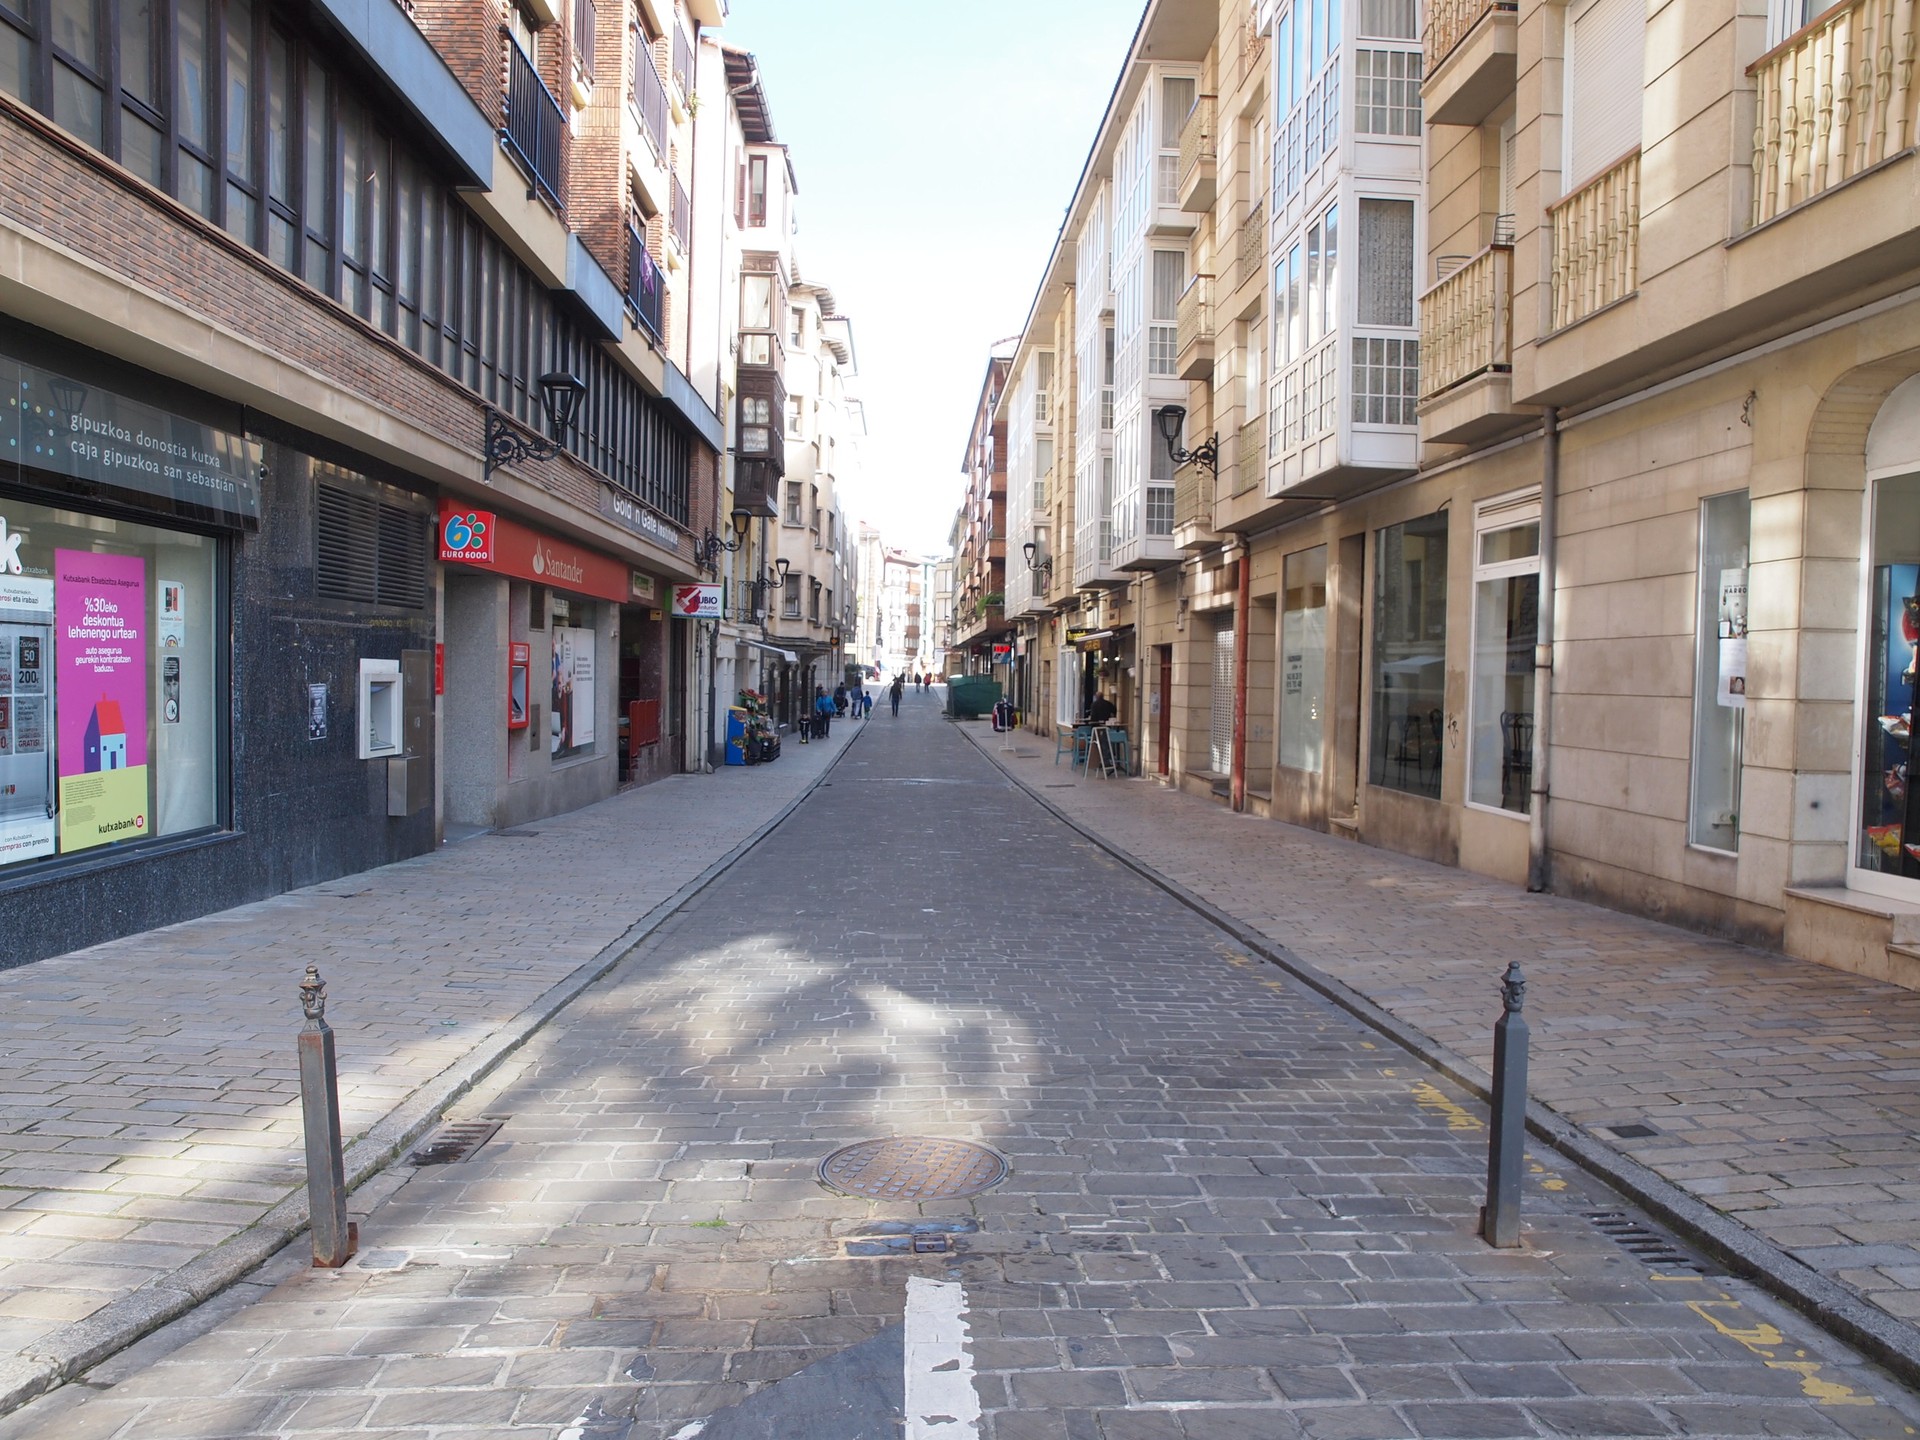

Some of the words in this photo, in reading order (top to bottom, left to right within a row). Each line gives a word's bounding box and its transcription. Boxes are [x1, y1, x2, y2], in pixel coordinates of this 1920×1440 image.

[70, 413, 131, 442] gipuzkoa
[136, 430, 188, 458] donostia
[191, 449, 221, 468] kutxa
[71, 441, 98, 460] caja
[104, 448, 159, 474] gipuzkoa
[163, 465, 182, 479] san
[187, 470, 234, 493] sebastián
[641, 508, 657, 533] Gate
[441, 550, 464, 558] EURO
[465, 551, 488, 559] 6000
[22, 565, 49, 575] utxabank
[545, 548, 584, 583] Santander
[84, 597, 118, 613] %30eko
[82, 613, 125, 627] deskontua
[68, 625, 111, 641] lehenengo
[112, 627, 137, 639] urtean
[24, 650, 35, 661] 50
[85, 646, 98, 655] auto
[98, 647, 122, 656] asegurua
[98, 818, 136, 834] kutxabank
[22, 840, 32, 848] con
[32, 836, 49, 848] premio
